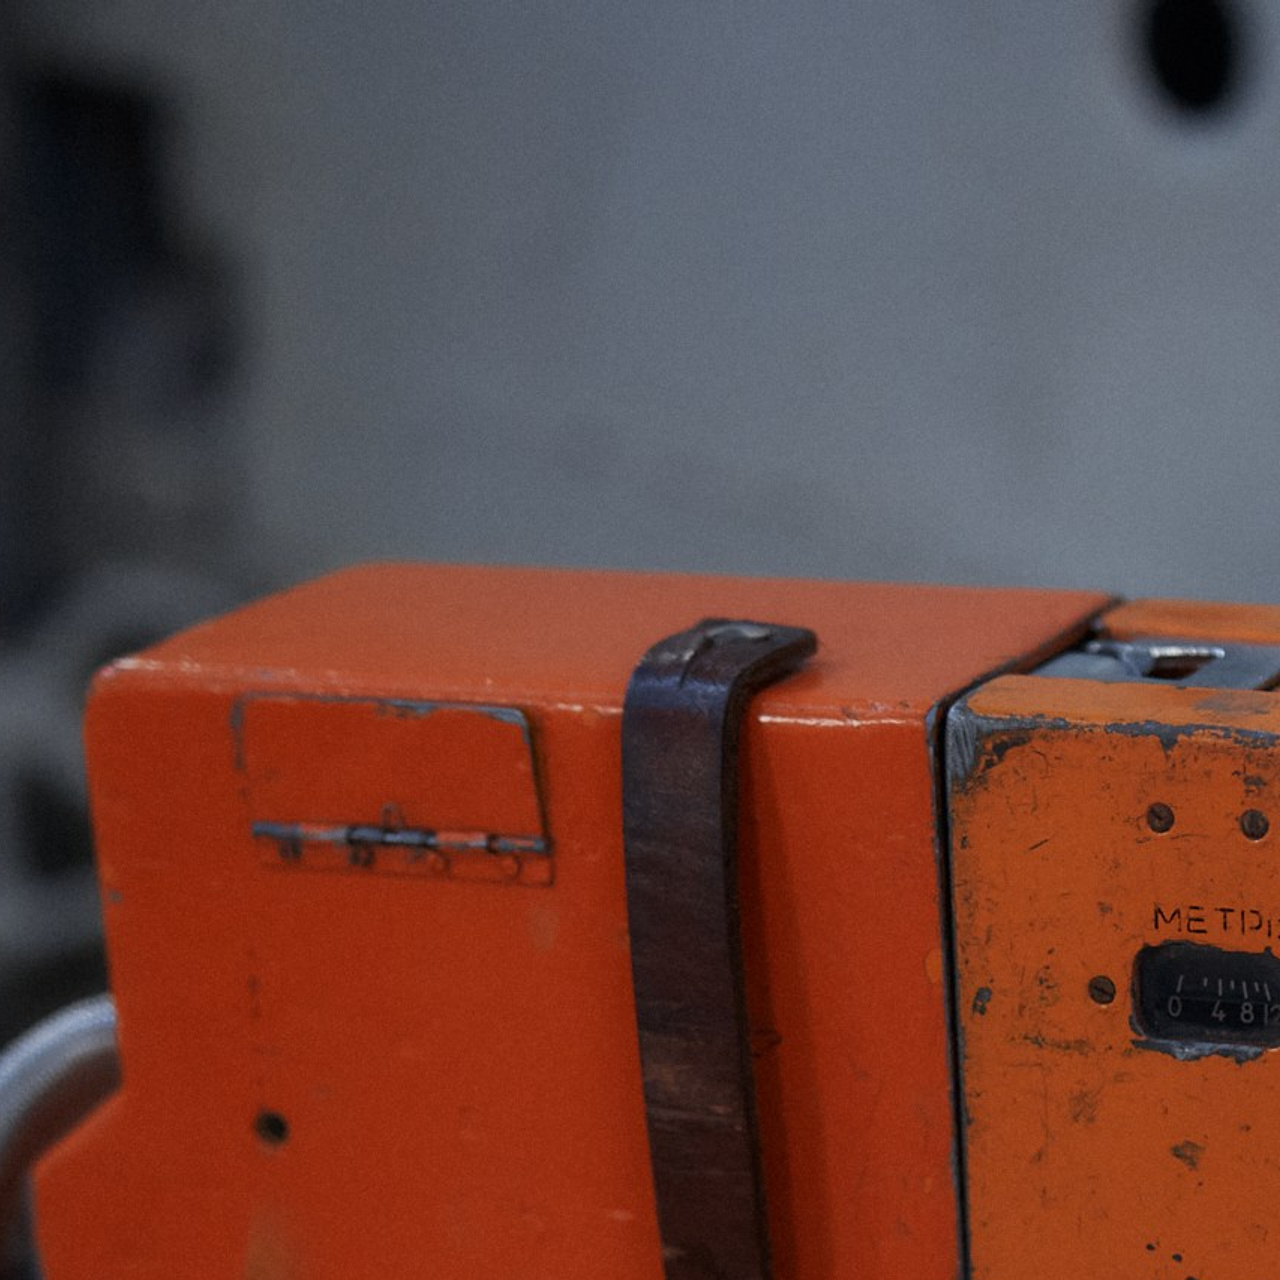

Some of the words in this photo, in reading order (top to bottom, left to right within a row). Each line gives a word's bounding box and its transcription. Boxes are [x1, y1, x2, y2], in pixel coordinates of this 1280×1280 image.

[1167, 995, 1183, 1018] 0
[1210, 999, 1227, 1022] 4
[1239, 1001, 1255, 1024] 8
